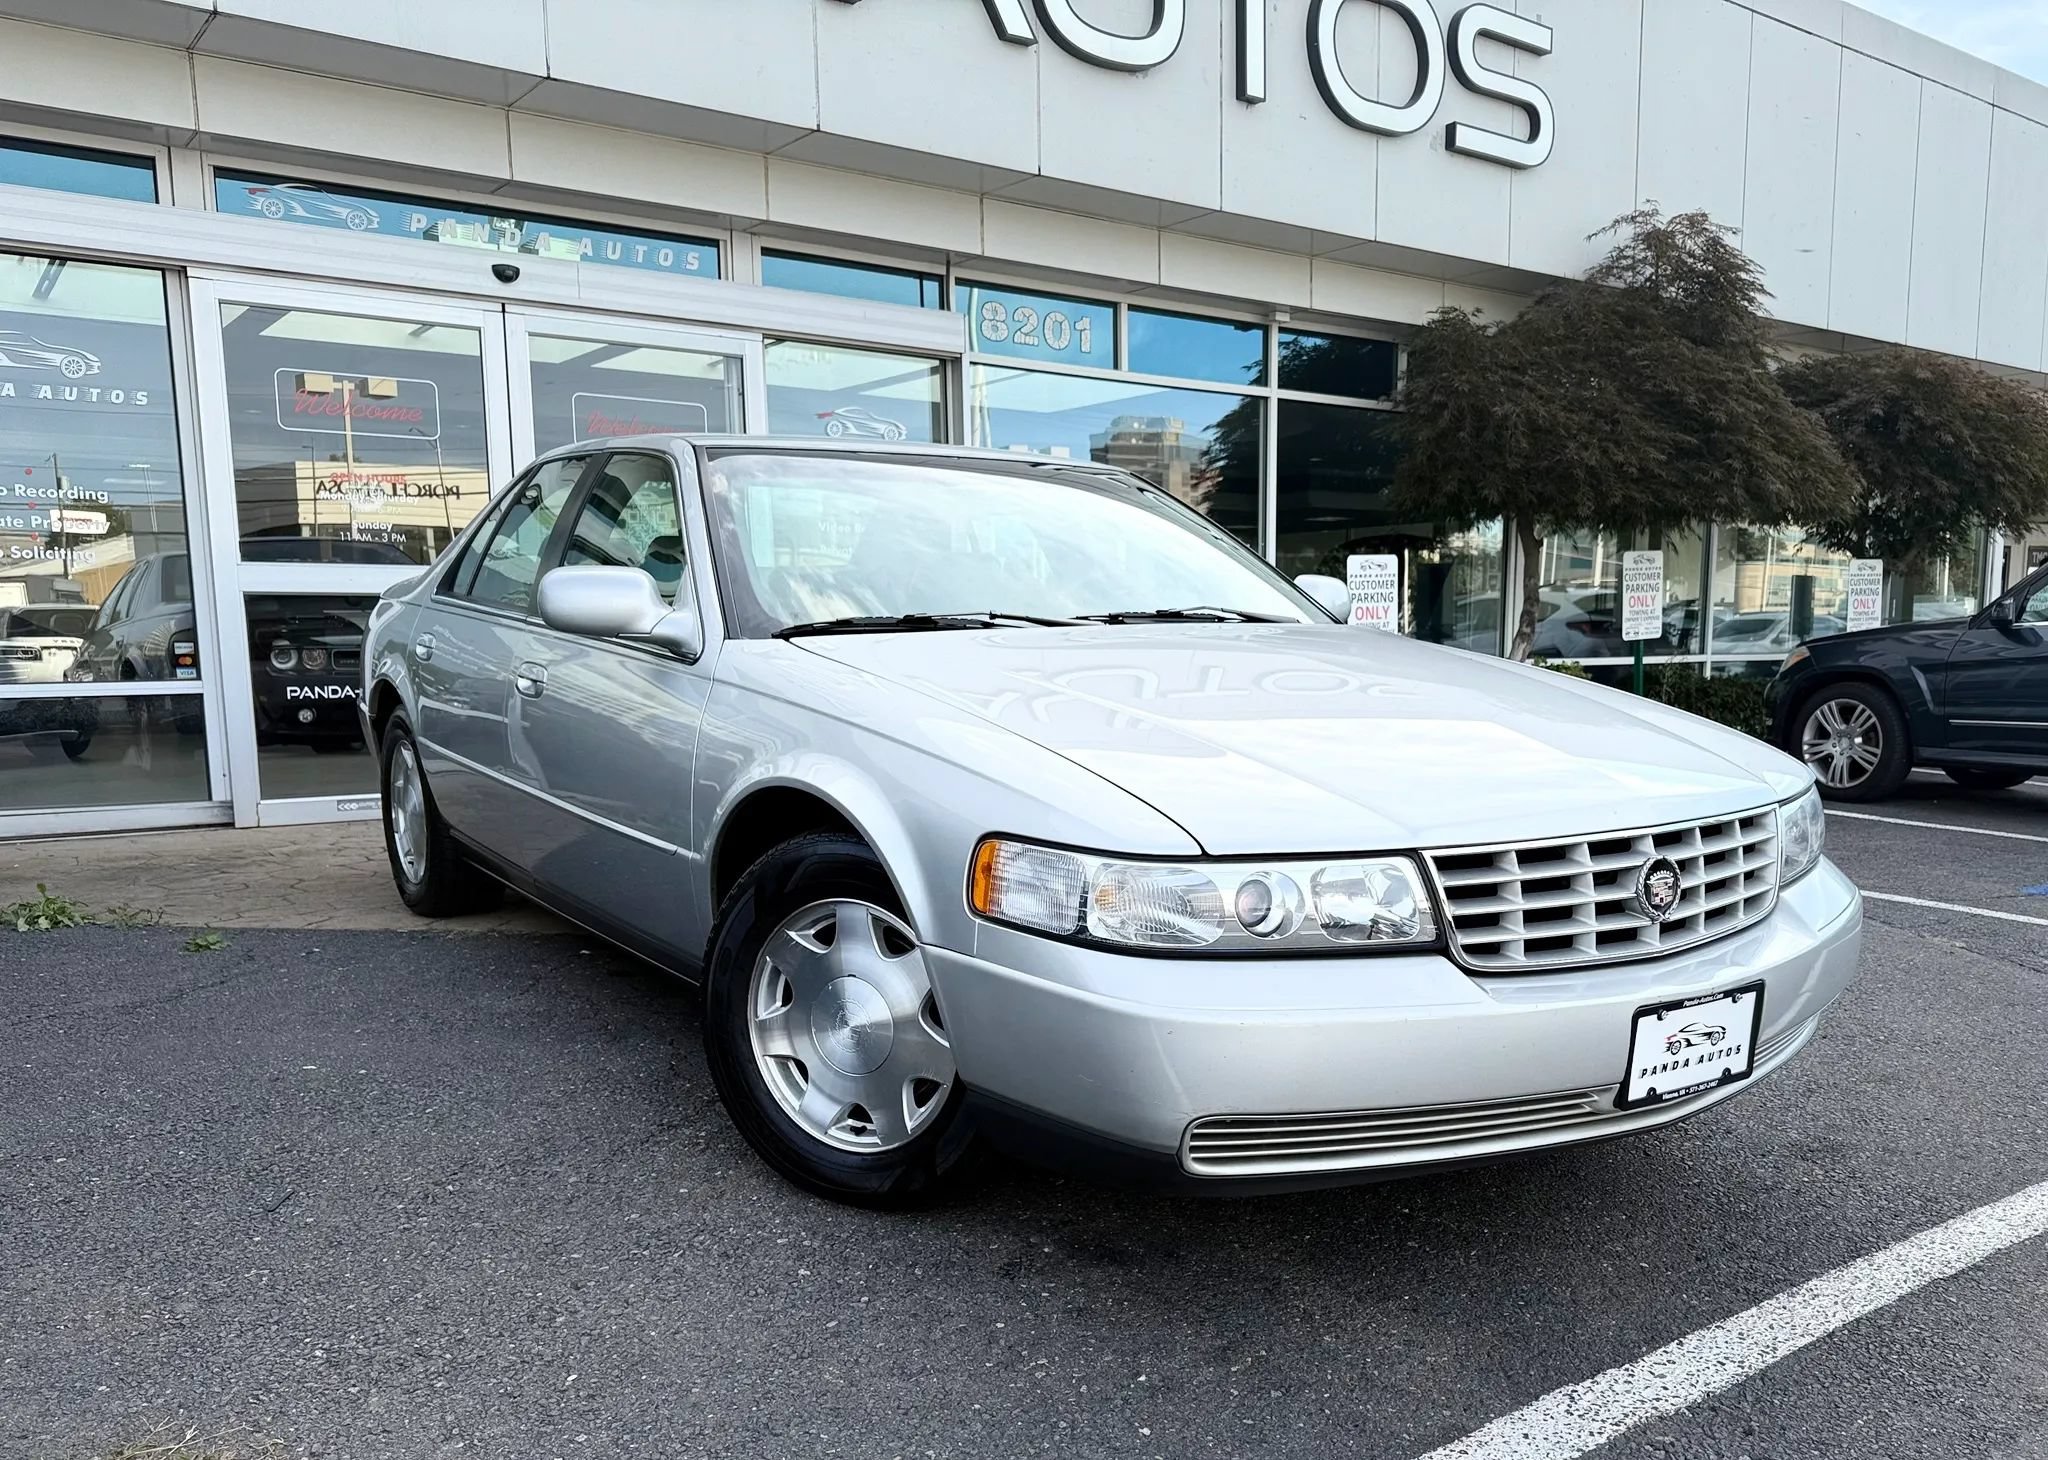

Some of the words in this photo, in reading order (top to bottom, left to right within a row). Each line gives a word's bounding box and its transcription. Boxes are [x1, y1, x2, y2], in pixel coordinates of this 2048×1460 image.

[406, 211, 552, 252] PANDA
[574, 237, 701, 271] AUTOS
[979, 299, 1093, 354] 8201
[36, 383, 149, 406] AUTOS
[294, 387, 424, 422] Welcome
[14, 483, 109, 504] Recording
[30, 515, 111, 533] Property
[351, 519, 393, 532] Sunday
[340, 532, 351, 541] 11
[356, 533, 372, 541] AM
[381, 533, 388, 542] 3
[391, 533, 407, 542] PM
[11, 545, 96, 564] Soliciting
[1624, 572, 1661, 582] CUSTOMER
[1850, 578, 1880, 587] CUSTOMER
[1349, 580, 1396, 590] CUSTOMER
[1625, 583, 1660, 594] PARKING
[1351, 592, 1394, 604] PARKING
[1851, 587, 1880, 597] PARKING
[1628, 594, 1657, 609] ONLY
[1852, 598, 1877, 609] ONLY
[1355, 606, 1390, 620] ONLY
[1382, 621, 1390, 629] AT
[1639, 1057, 1690, 1079] PANDA
[1696, 1044, 1742, 1065] AUTOS
